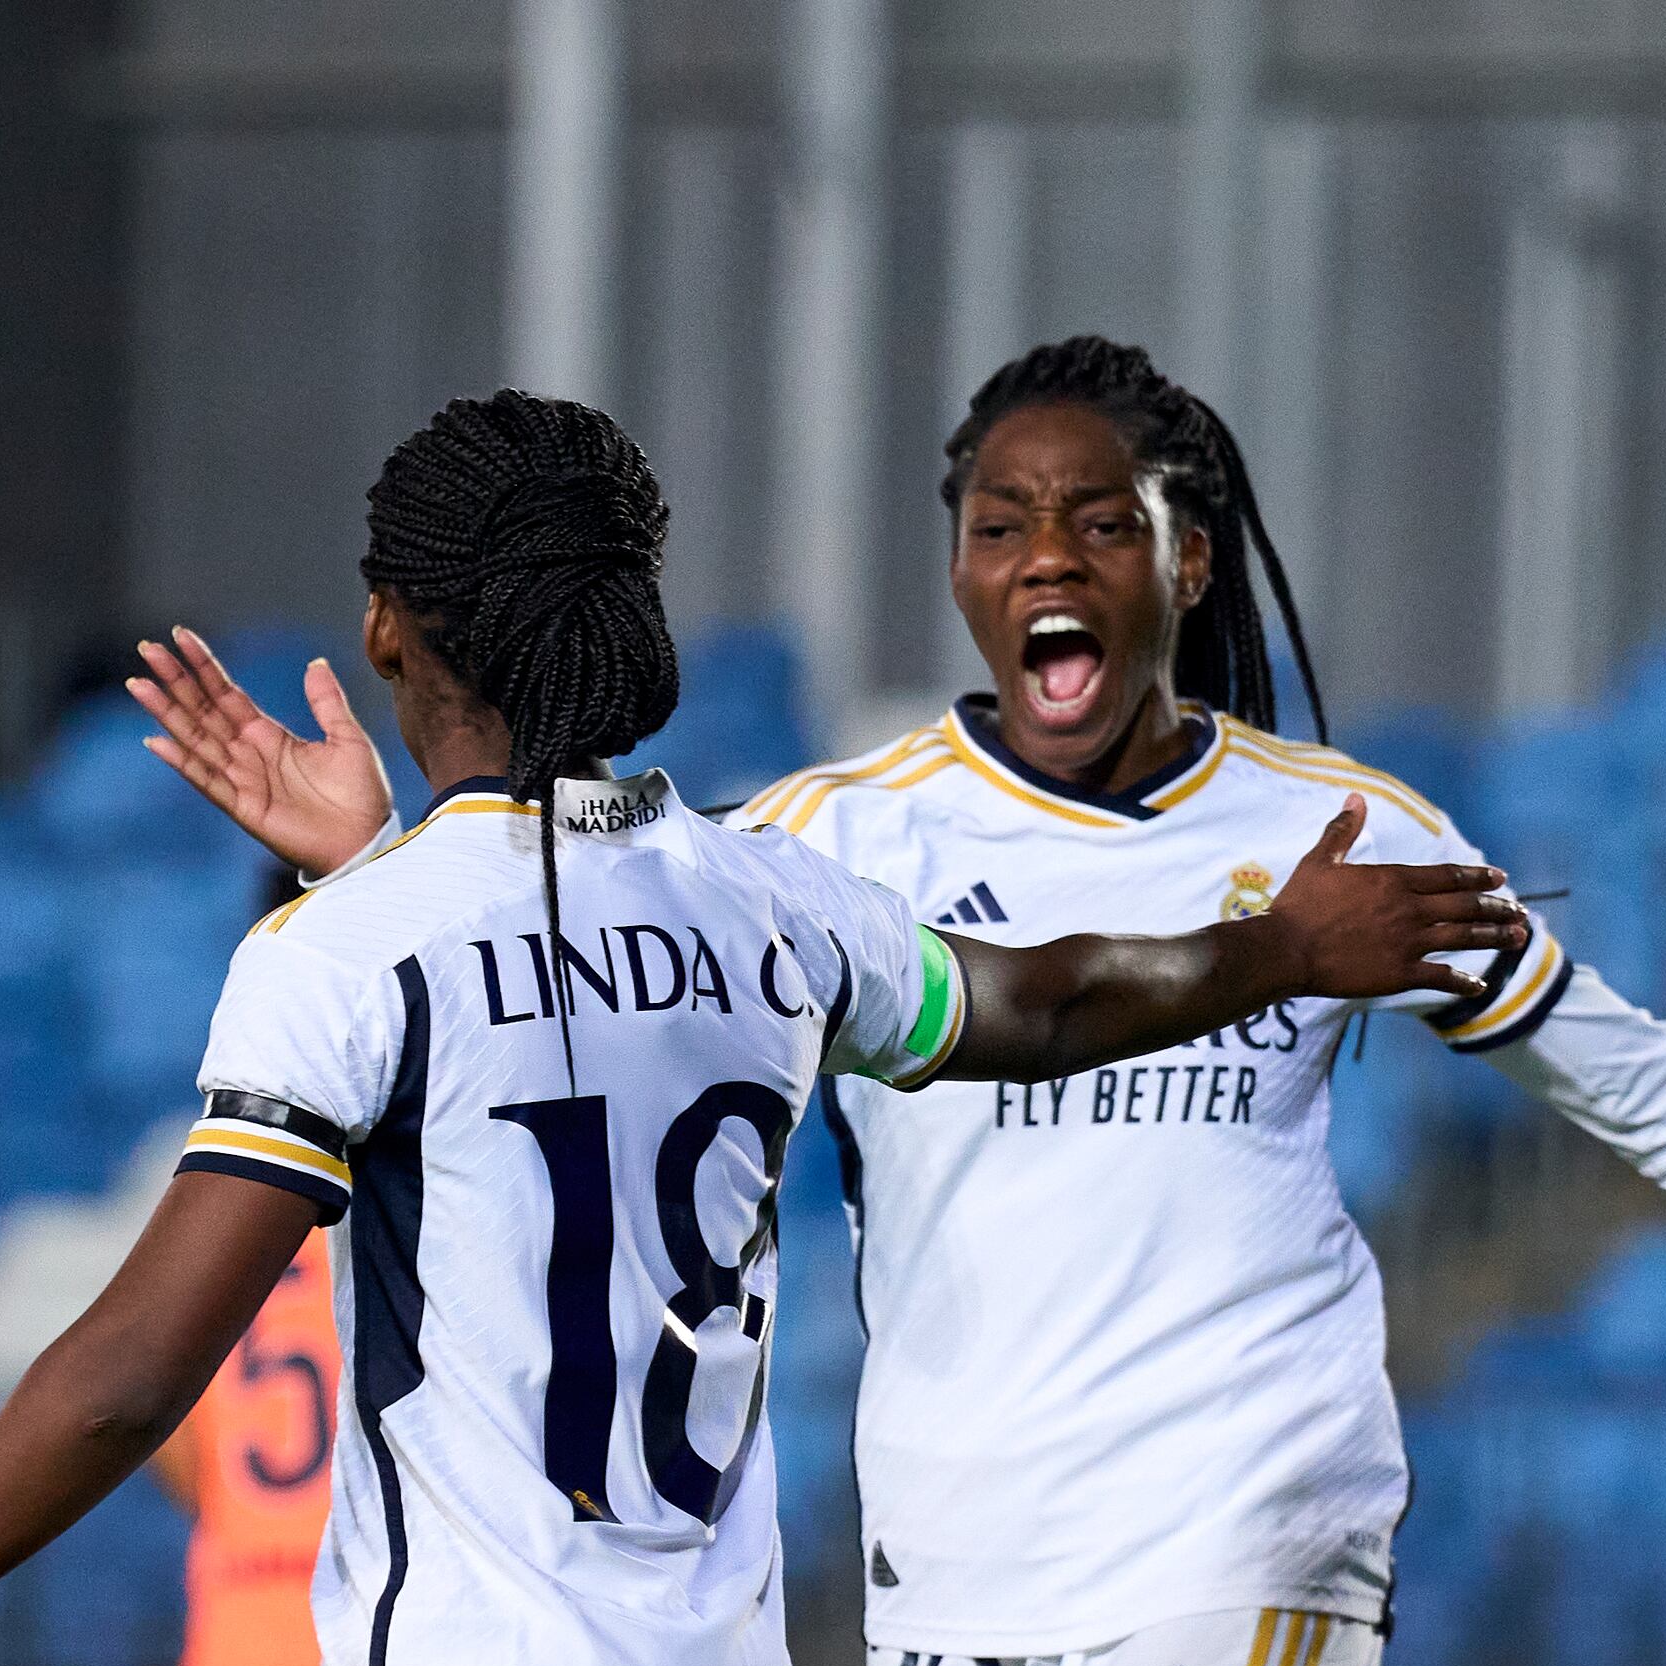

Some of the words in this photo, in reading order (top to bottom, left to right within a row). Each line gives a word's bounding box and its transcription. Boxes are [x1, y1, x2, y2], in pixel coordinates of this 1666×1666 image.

[565, 802, 666, 834] MADRID!
[467, 923, 733, 1026] LINDA
[995, 1076, 1069, 1128] FLY
[1092, 1064, 1256, 1126] BETTER
[488, 1080, 793, 1528] 18
